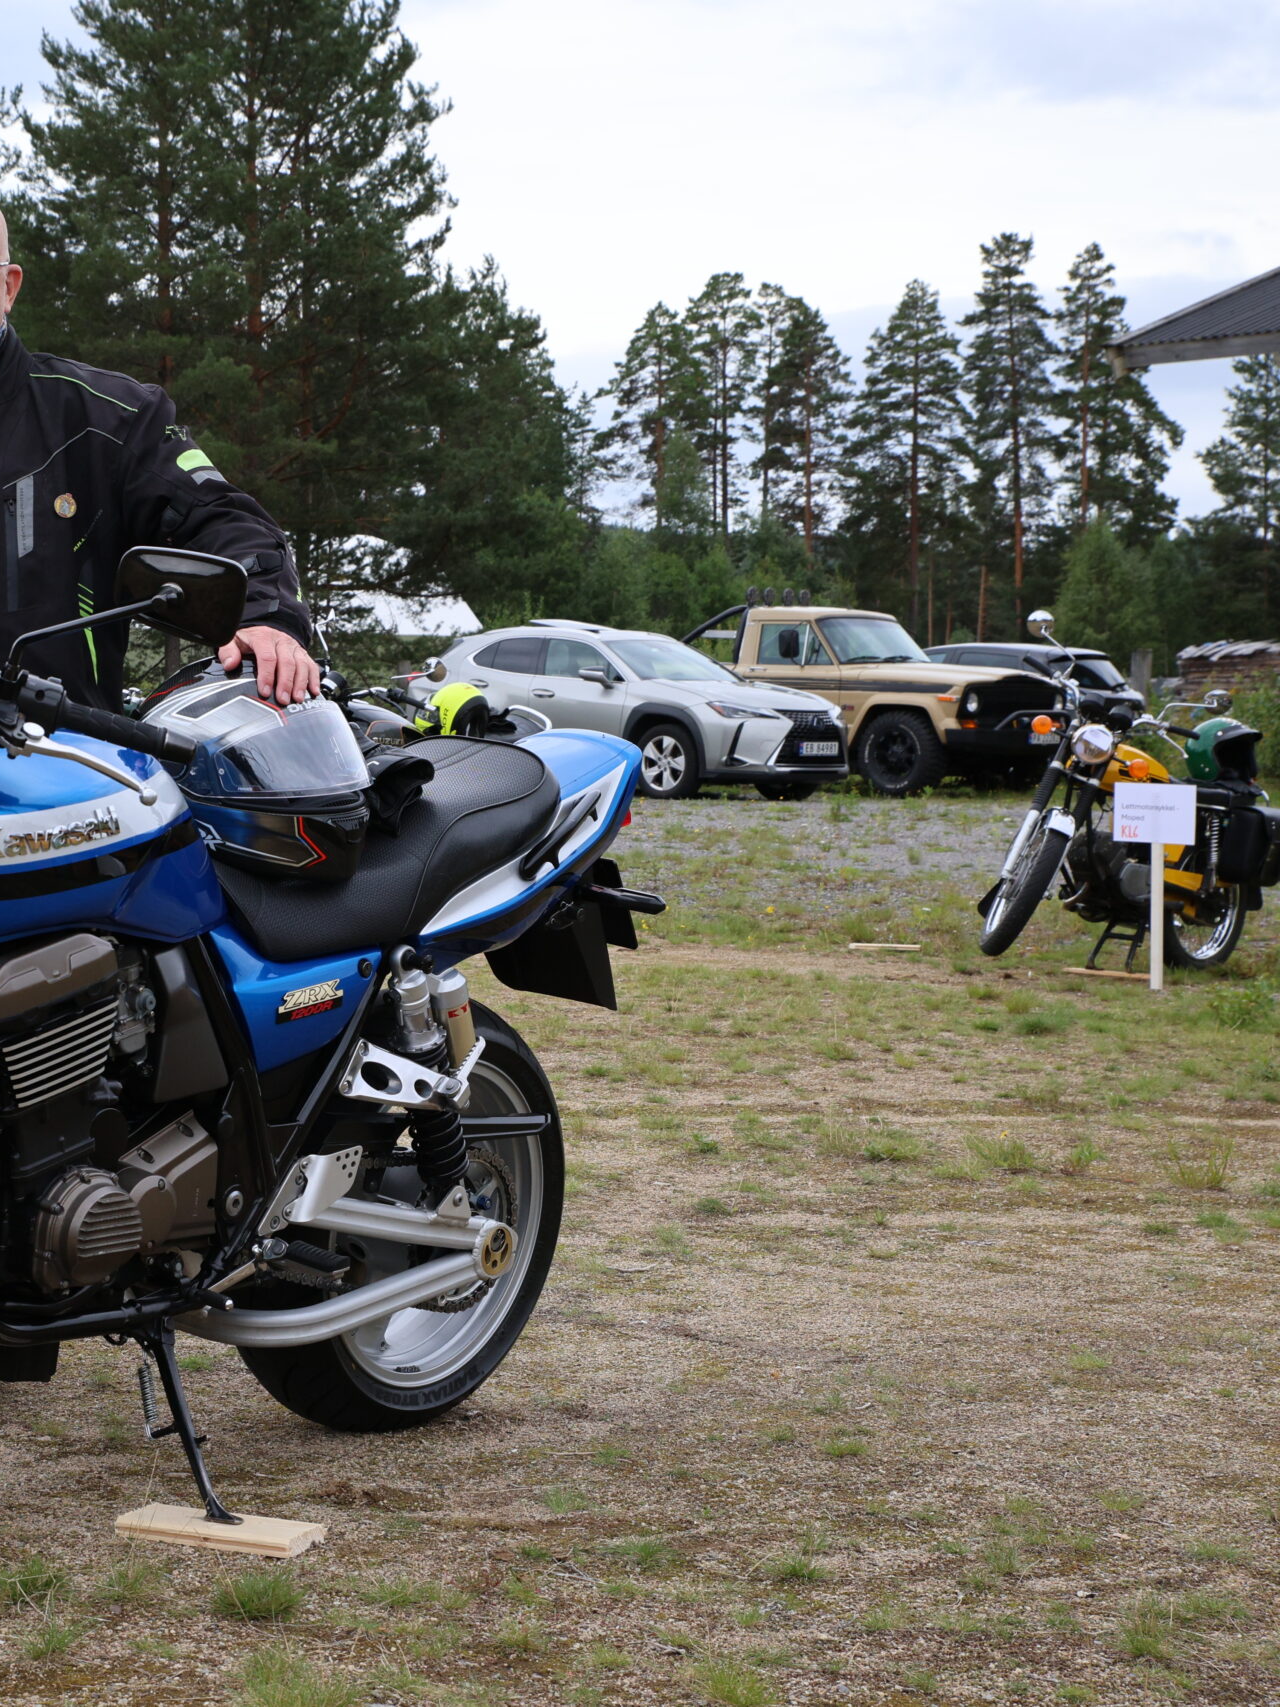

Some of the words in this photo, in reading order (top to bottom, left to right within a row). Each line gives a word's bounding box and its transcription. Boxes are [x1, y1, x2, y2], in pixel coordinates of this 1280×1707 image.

[1121, 814, 1145, 822] Moped
[283, 979, 339, 1011] ZRX
[291, 1000, 334, 1020] 1200R
